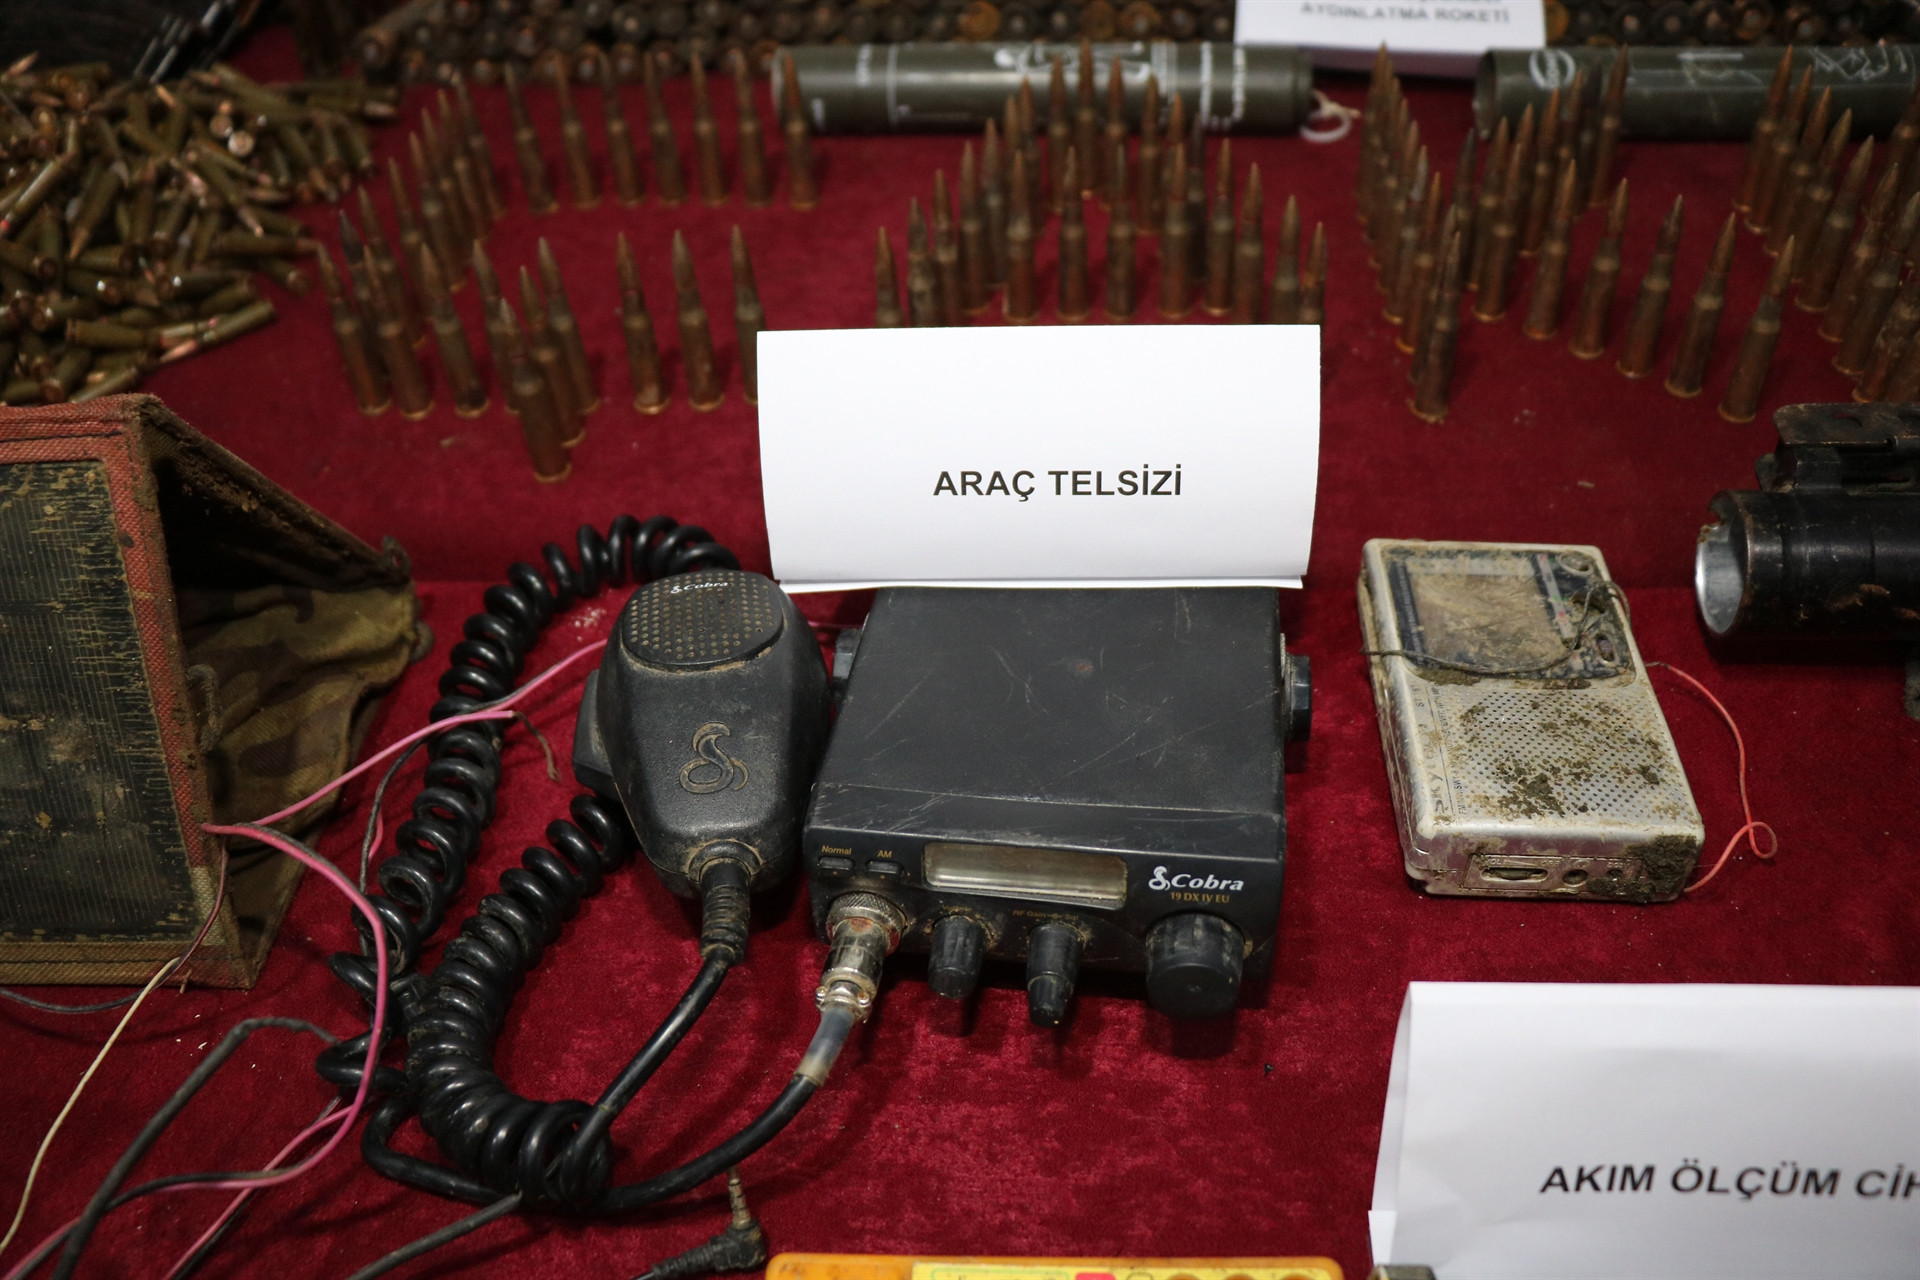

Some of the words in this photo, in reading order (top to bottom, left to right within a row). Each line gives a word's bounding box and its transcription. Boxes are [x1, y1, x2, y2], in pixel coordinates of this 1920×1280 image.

[933, 470, 1035, 502] ARAÇ
[1048, 464, 1182, 496] TELSİZİ
[821, 845, 852, 855] Normal
[877, 850, 893, 858] AM
[1171, 873, 1244, 891] Cobra
[1171, 891, 1182, 900] 19
[1183, 892, 1199, 902] DX
[1215, 894, 1230, 903] EU
[1539, 1164, 1656, 1193] AKIM
[1670, 1158, 1841, 1200] ÖLÇÜM
